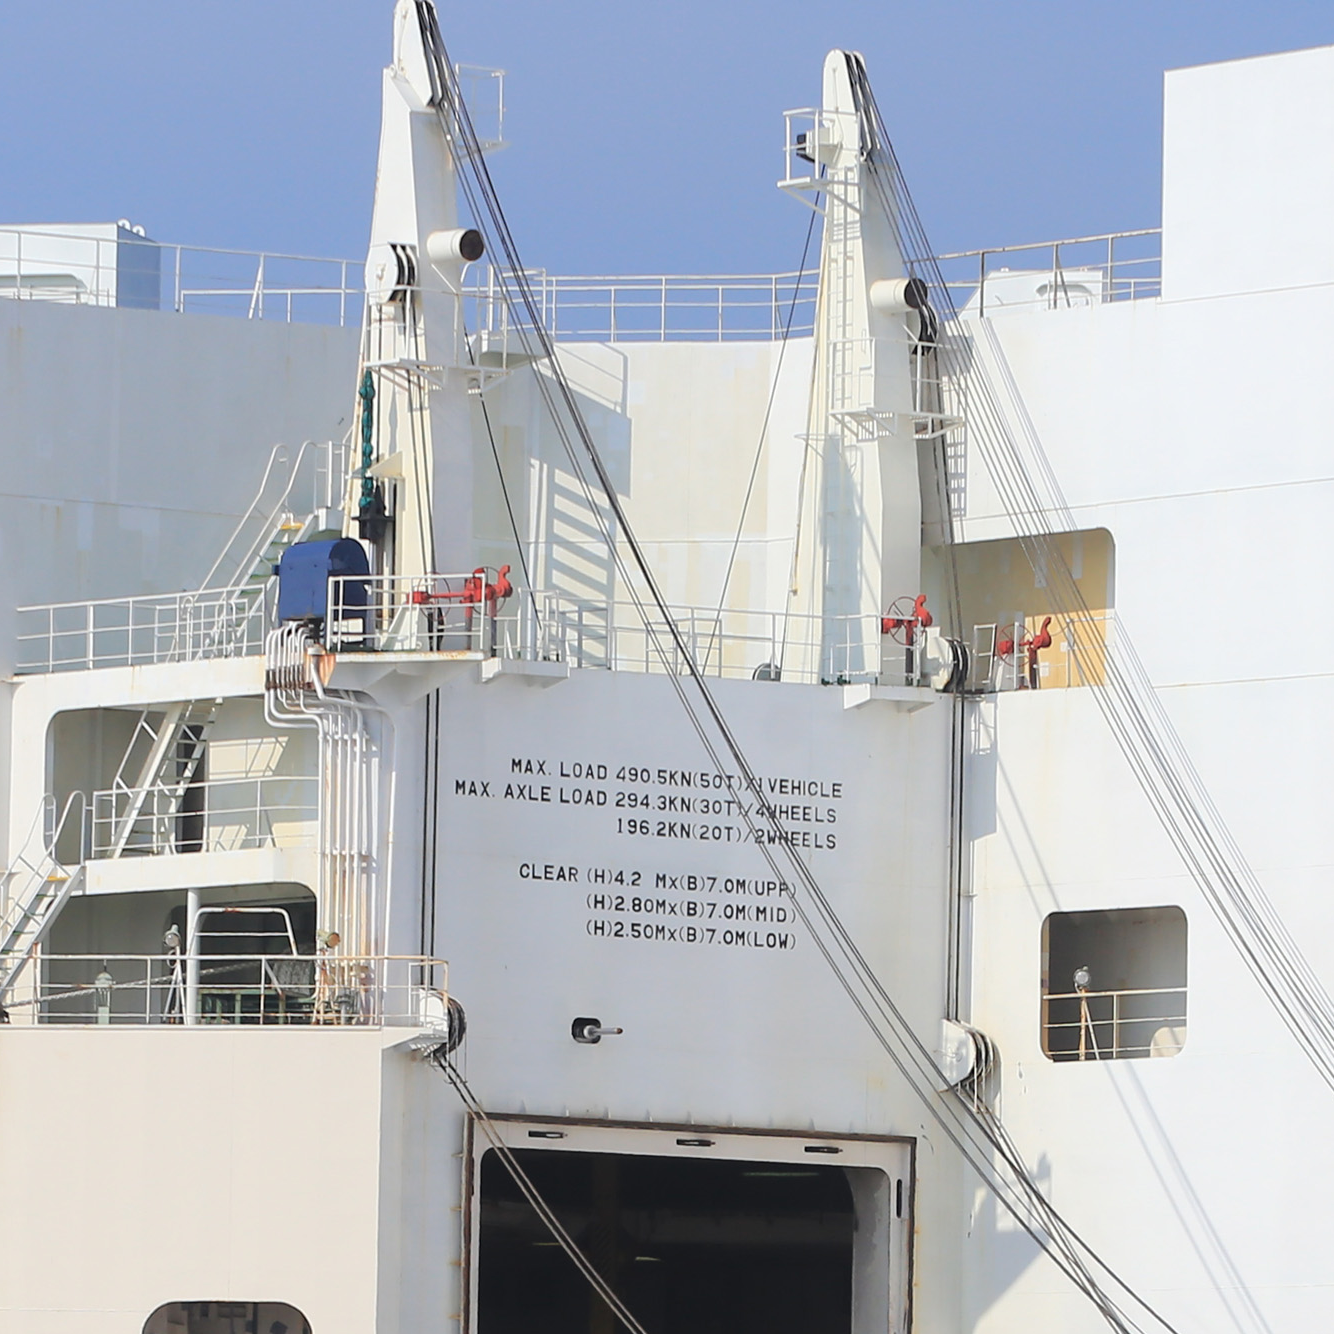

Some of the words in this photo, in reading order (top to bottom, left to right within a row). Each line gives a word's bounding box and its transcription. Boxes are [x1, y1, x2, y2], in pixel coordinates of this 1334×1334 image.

[511, 757, 552, 776] MAX.
[560, 761, 608, 780] LOAD
[455, 780, 496, 798] MAX.
[504, 783, 552, 802] AXLE
[560, 787, 608, 806] LOAD
[519, 863, 579, 882] CLEAR
